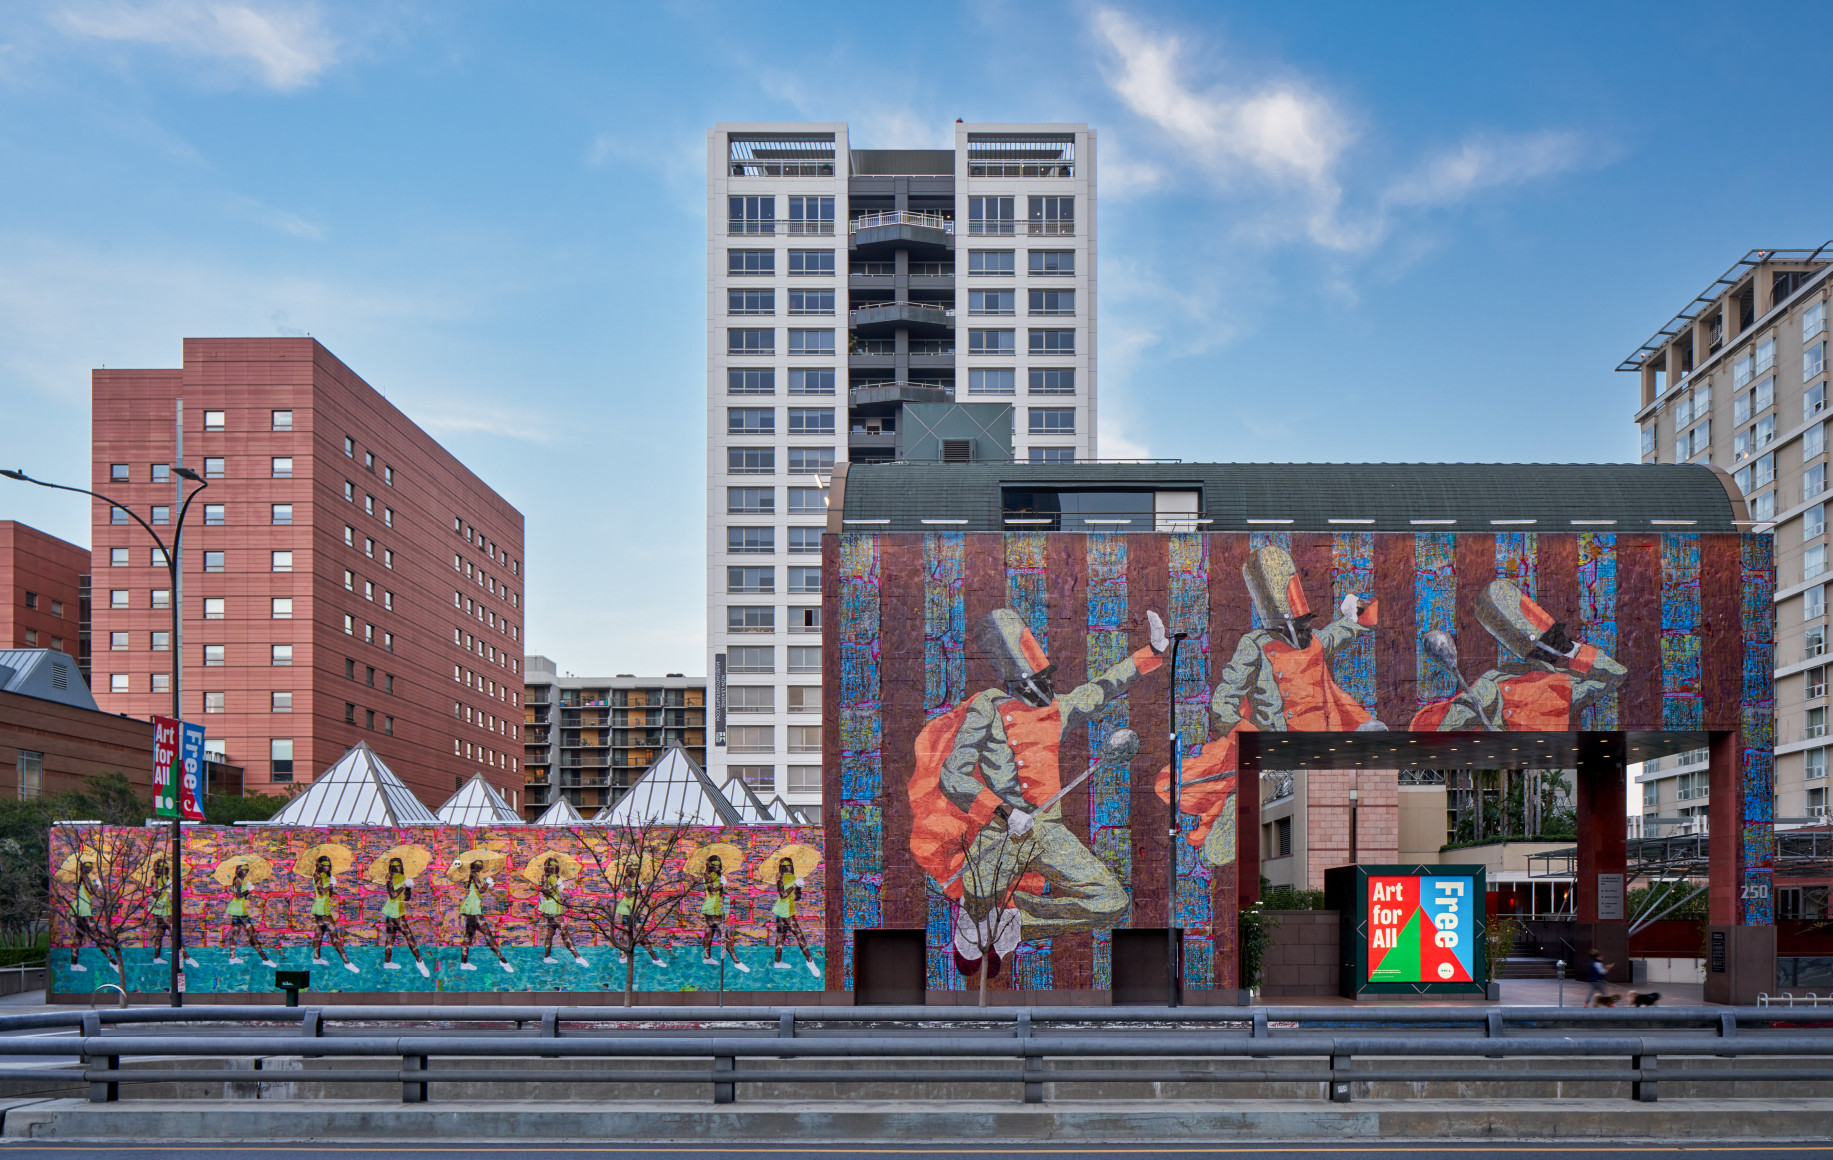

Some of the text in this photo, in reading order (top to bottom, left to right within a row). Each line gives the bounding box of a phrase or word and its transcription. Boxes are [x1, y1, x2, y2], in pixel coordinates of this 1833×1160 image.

[155, 723, 175, 745] Art
[155, 743, 174, 765] for
[184, 729, 202, 790] Free
[154, 765, 170, 786] All
[1372, 882, 1403, 901] Art
[1740, 885, 1769, 899] 250
[1372, 904, 1403, 925] for
[1434, 881, 1464, 948] Free
[1372, 928, 1398, 948] All
